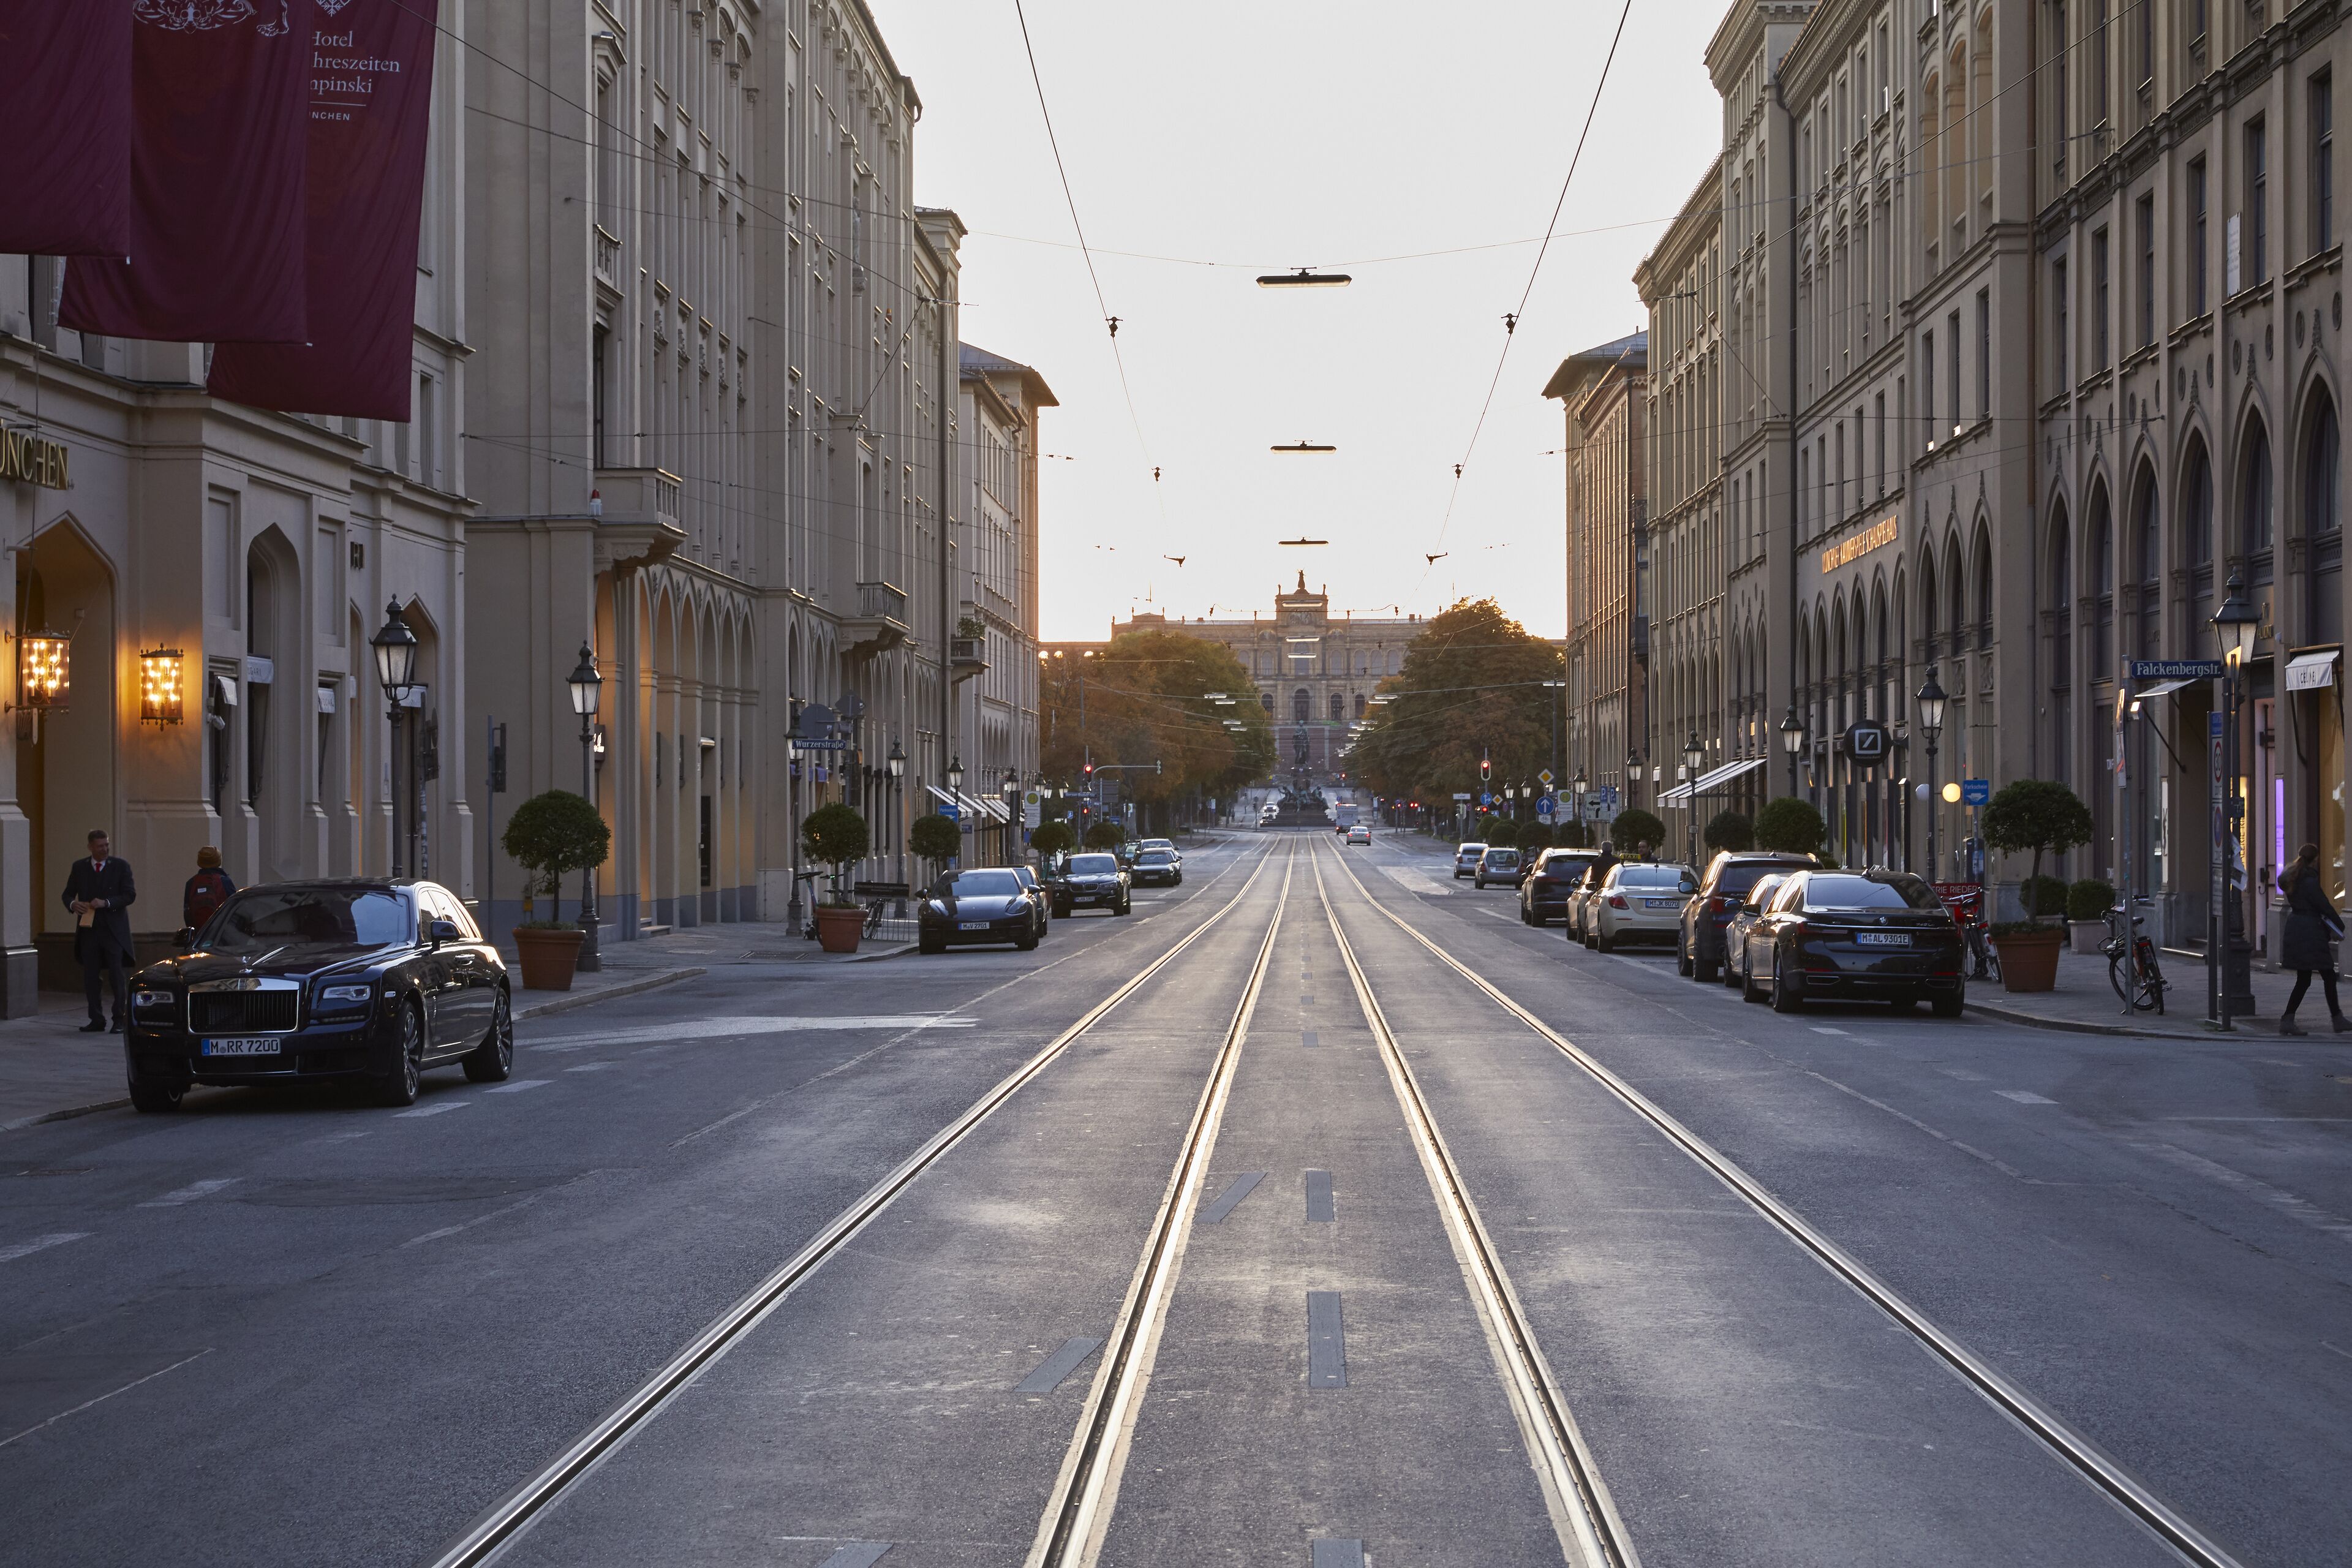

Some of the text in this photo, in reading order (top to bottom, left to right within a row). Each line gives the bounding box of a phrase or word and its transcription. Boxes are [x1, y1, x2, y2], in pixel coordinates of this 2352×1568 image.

[309, 111, 350, 121] NCHEN
[2136, 663, 2220, 677] Falckenbergstr.
[796, 740, 843, 749] Wurzerstraße
[1863, 934, 1908, 944] M AL 9301E
[211, 1039, 279, 1054] M RR 7200
